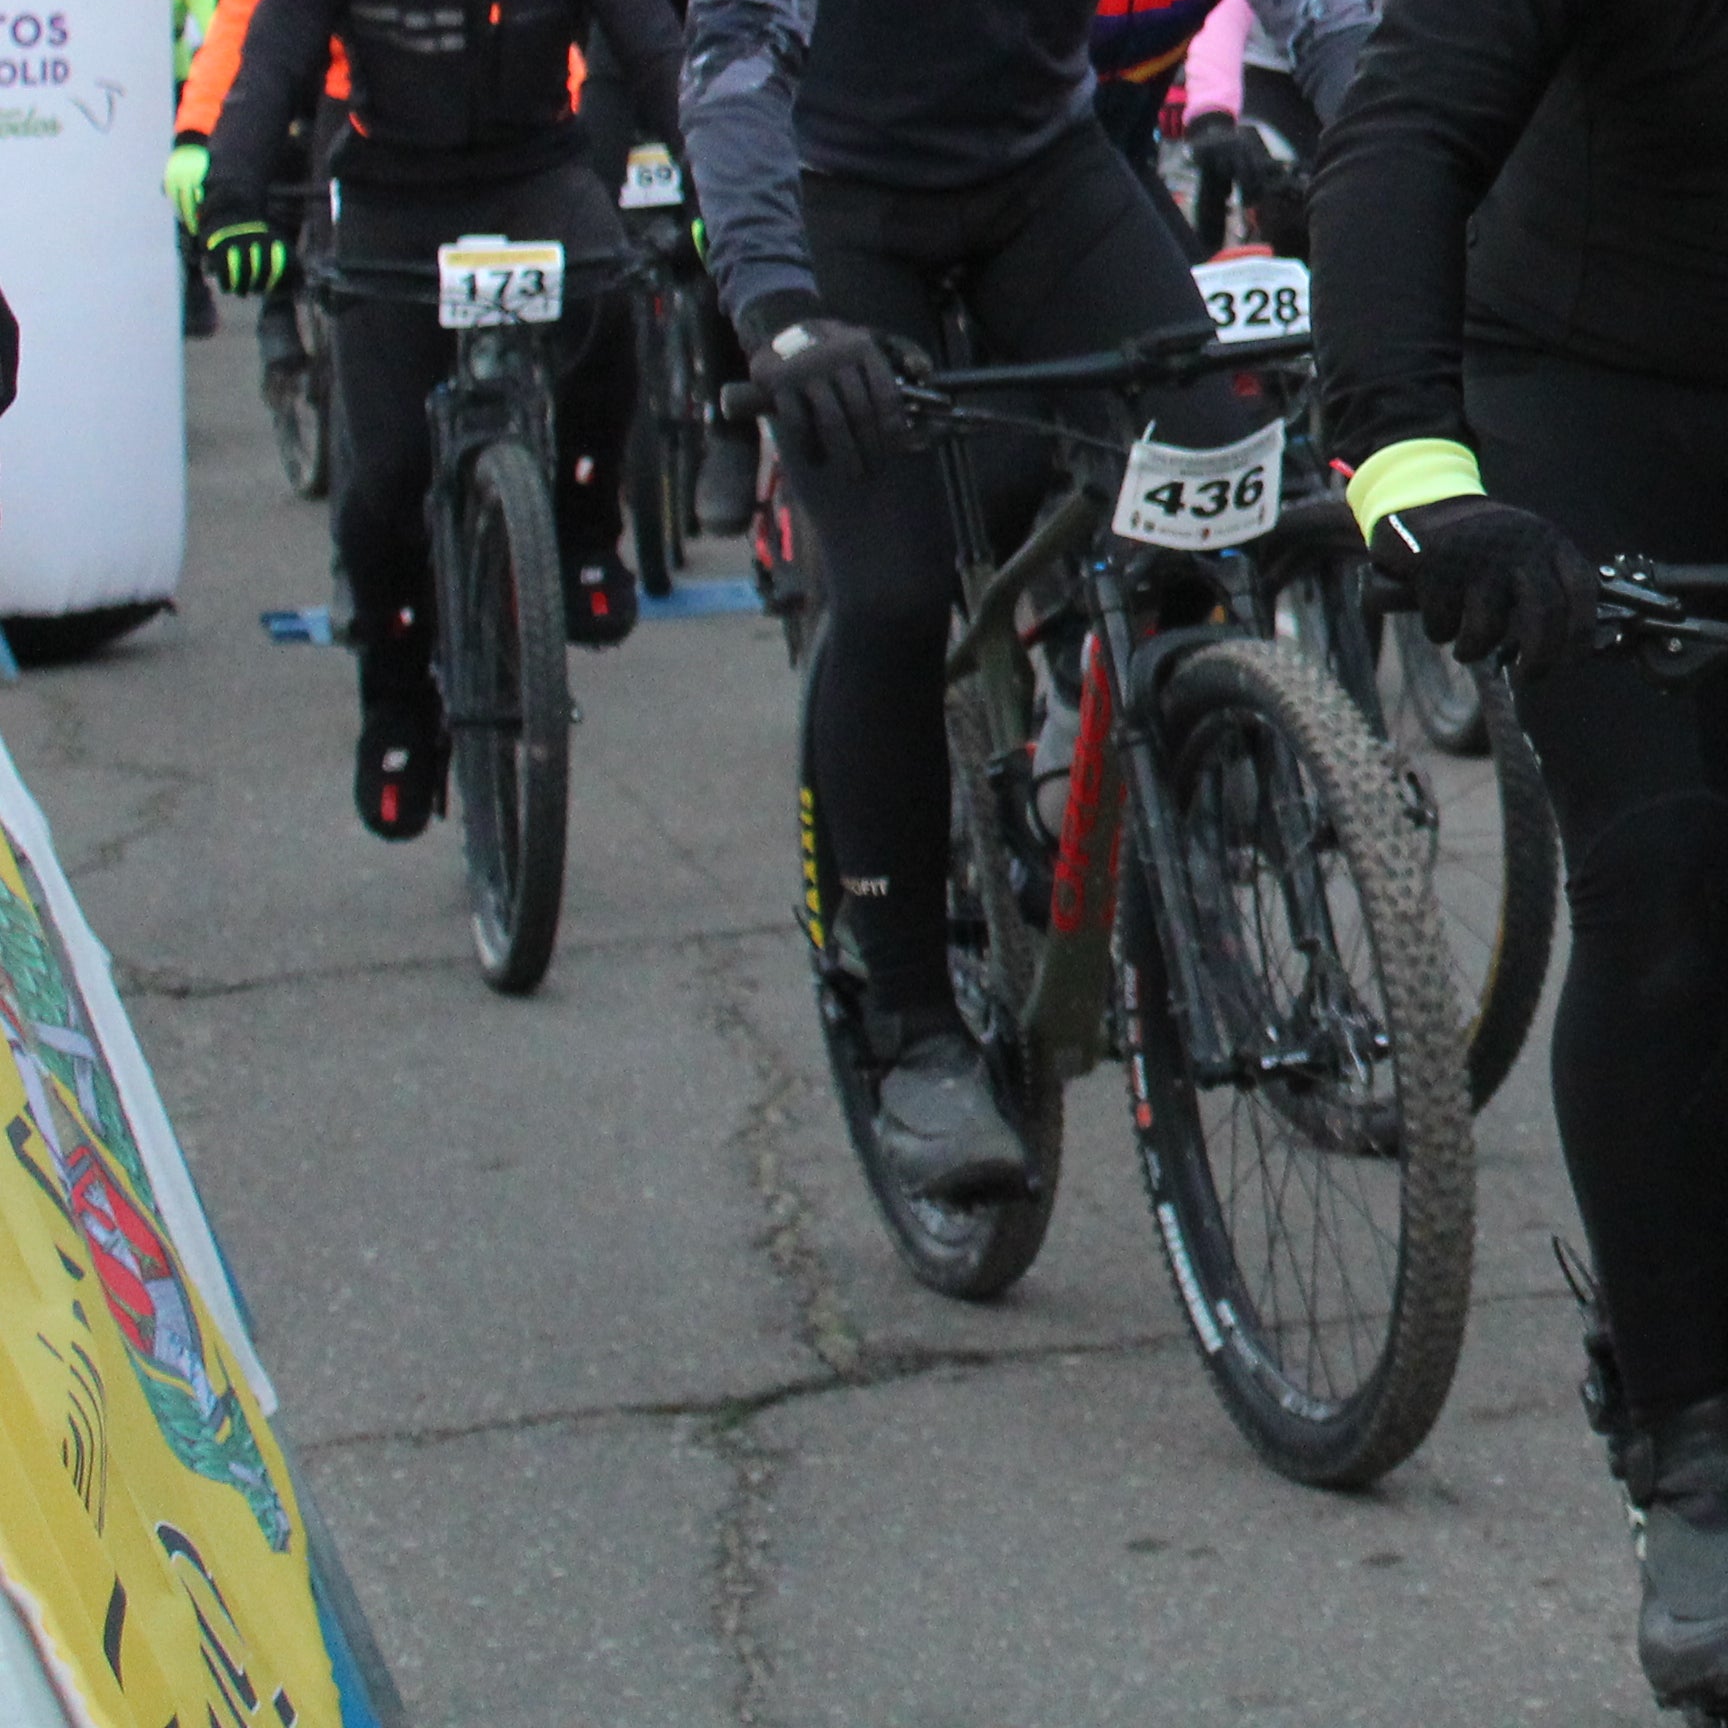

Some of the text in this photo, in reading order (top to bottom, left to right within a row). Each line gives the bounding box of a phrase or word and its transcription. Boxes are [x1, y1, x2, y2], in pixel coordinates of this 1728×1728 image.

[460, 269, 547, 306] 173
[1206, 286, 1301, 328] 328
[1144, 465, 1264, 518] 436
